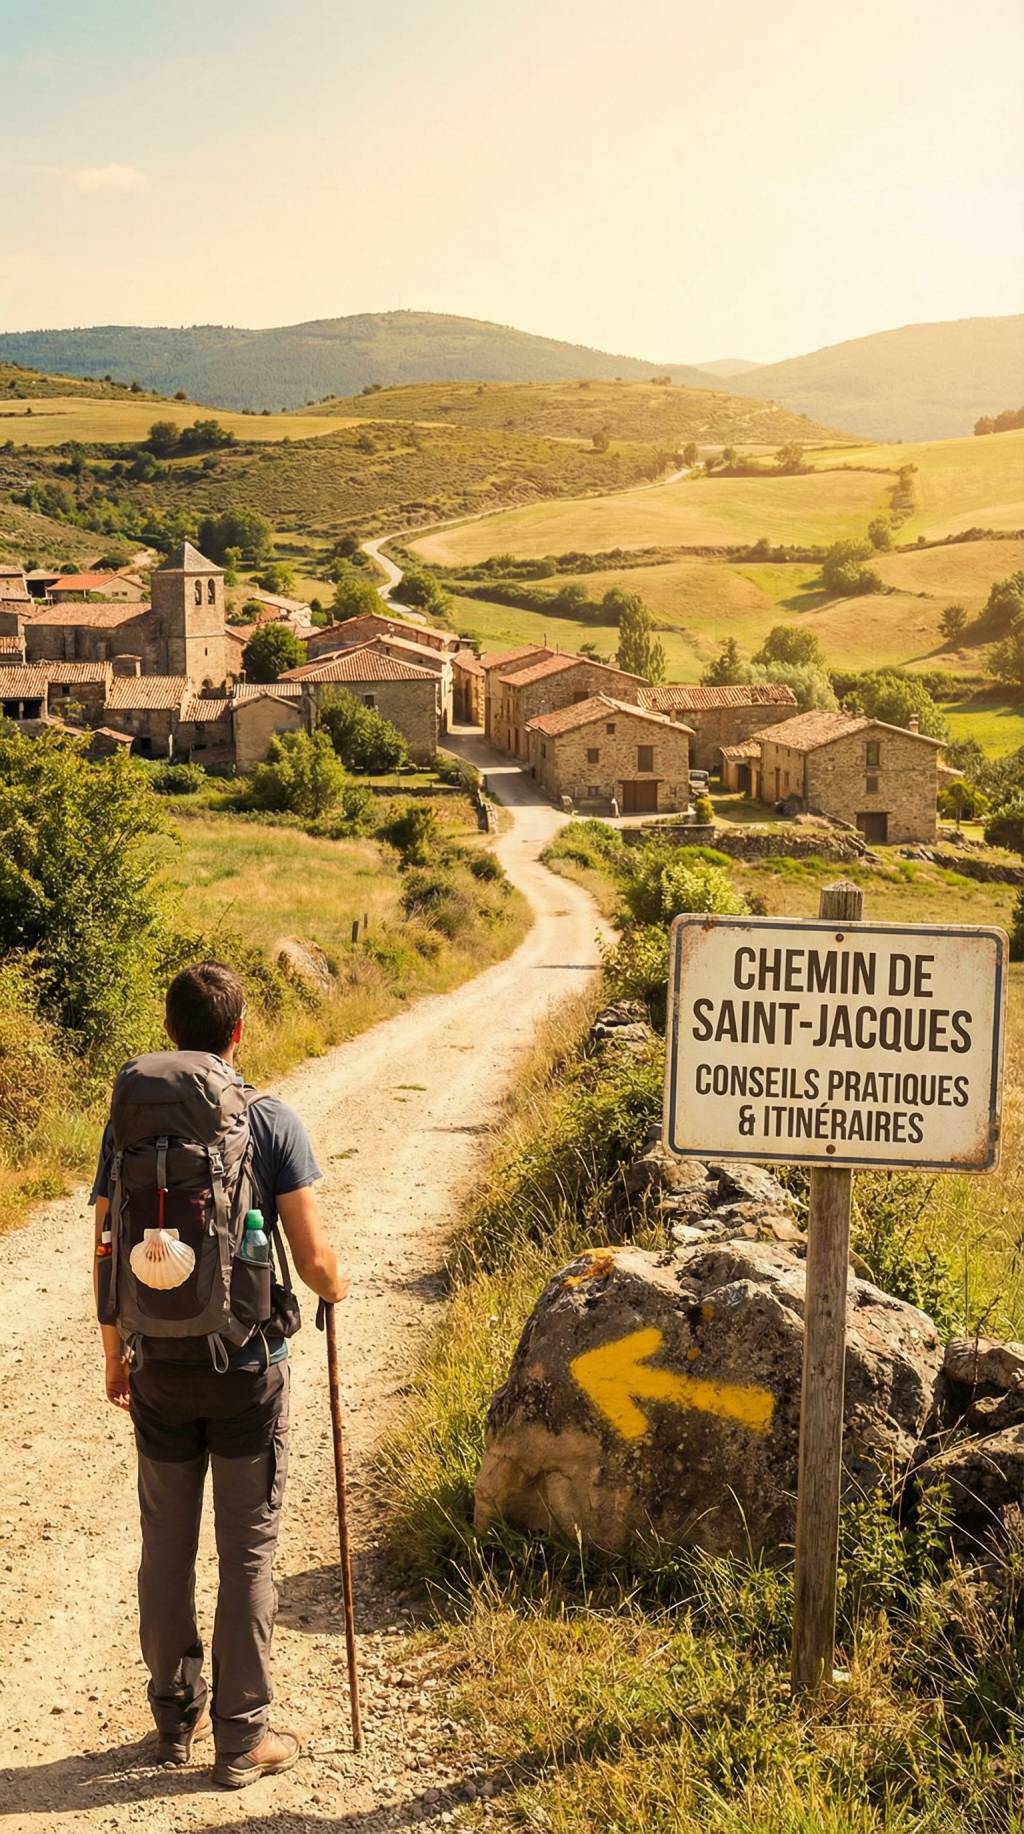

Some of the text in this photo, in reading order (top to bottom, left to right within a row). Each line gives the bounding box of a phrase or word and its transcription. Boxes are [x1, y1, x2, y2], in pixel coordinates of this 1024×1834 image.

[733, 946, 935, 998] CHEMIN DE
[692, 998, 973, 1054] SAINT-JACQUES
[695, 1063, 969, 1107] CONSEILS PRATIQUES
[738, 1102, 924, 1144] & ITINÉRAIRES
